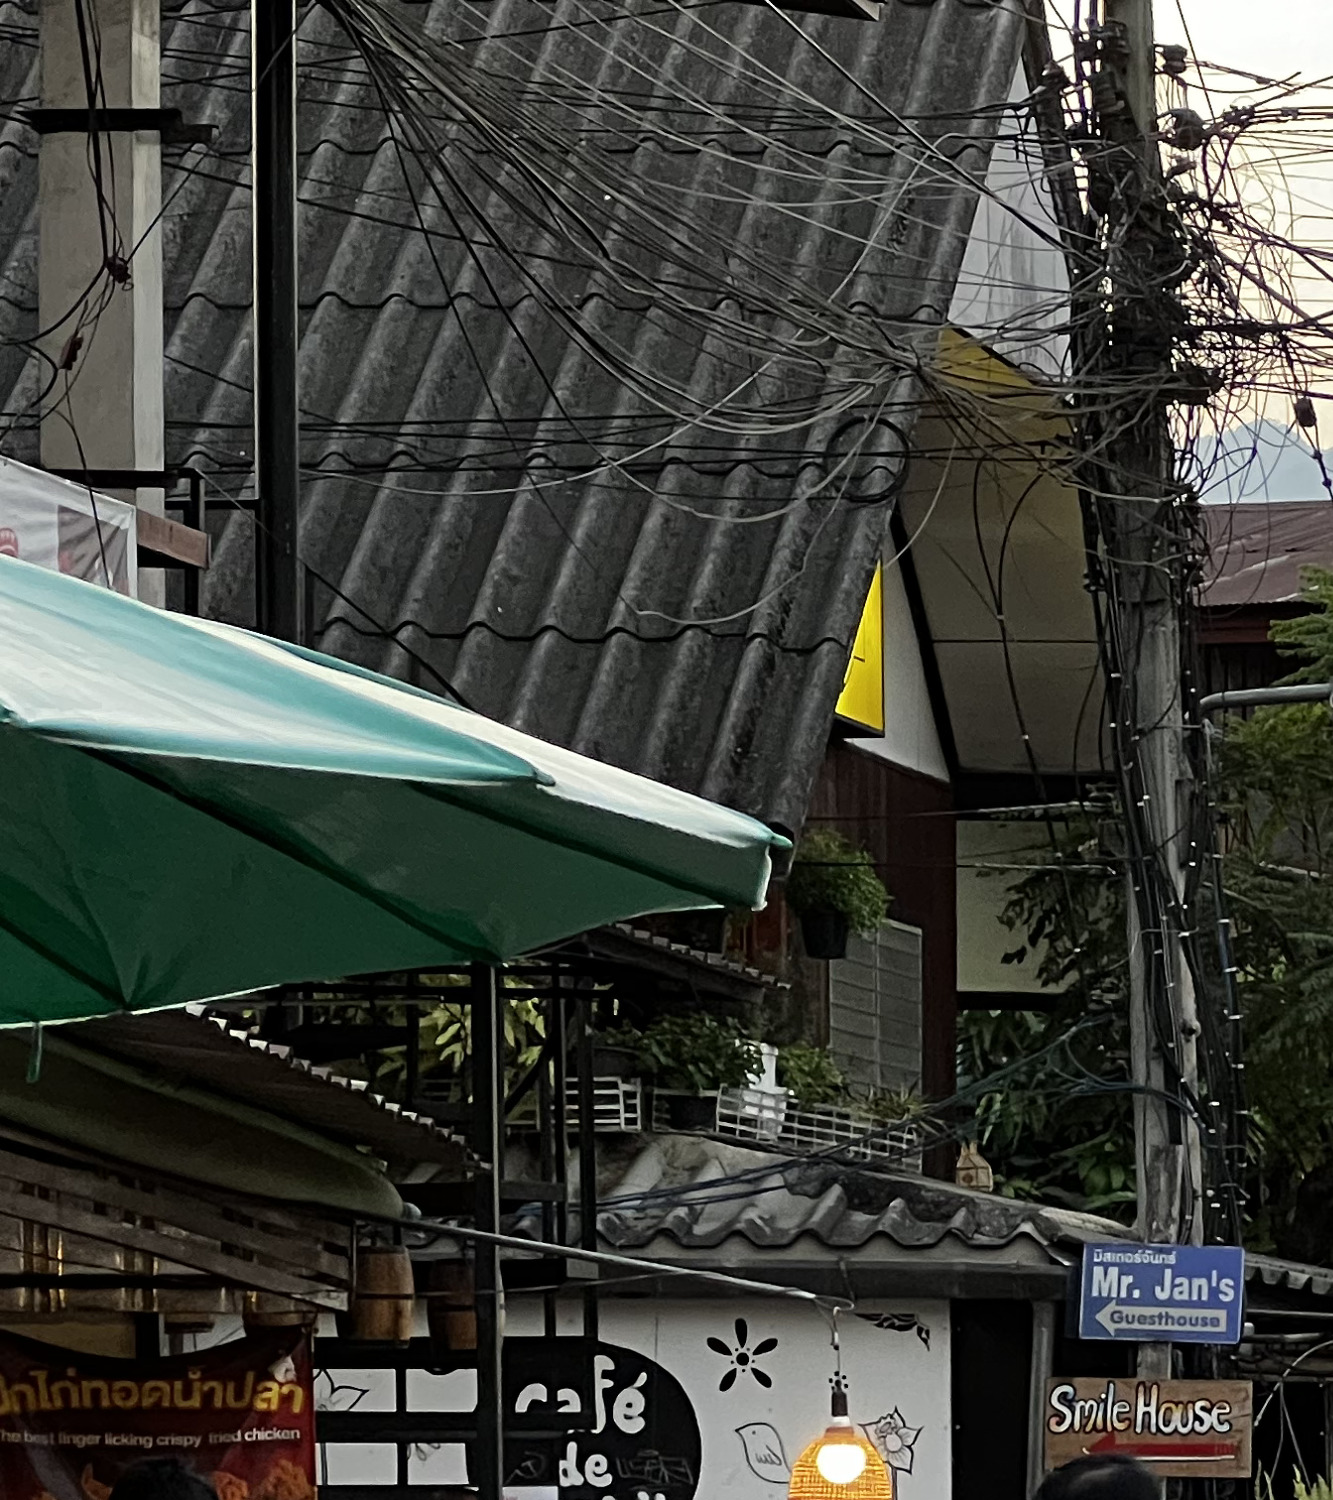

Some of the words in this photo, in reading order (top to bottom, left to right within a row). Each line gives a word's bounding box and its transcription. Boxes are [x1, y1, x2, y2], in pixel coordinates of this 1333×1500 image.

[1091, 1266, 1141, 1299] Mr.
[1154, 1268, 1235, 1302] Jan's
[1109, 1310, 1221, 1329] Guesthouse
[0, 1365, 304, 1416] กไก่ทอดน้ำปลา
[1049, 1382, 1131, 1434] Smile
[1135, 1382, 1233, 1435] House
[0, 1429, 21, 1443] he
[104, 1431, 153, 1449] licking
[156, 1433, 202, 1448] crispy
[209, 1424, 241, 1444] fried
[244, 1426, 300, 1442] chicken
[559, 1441, 613, 1487] de
